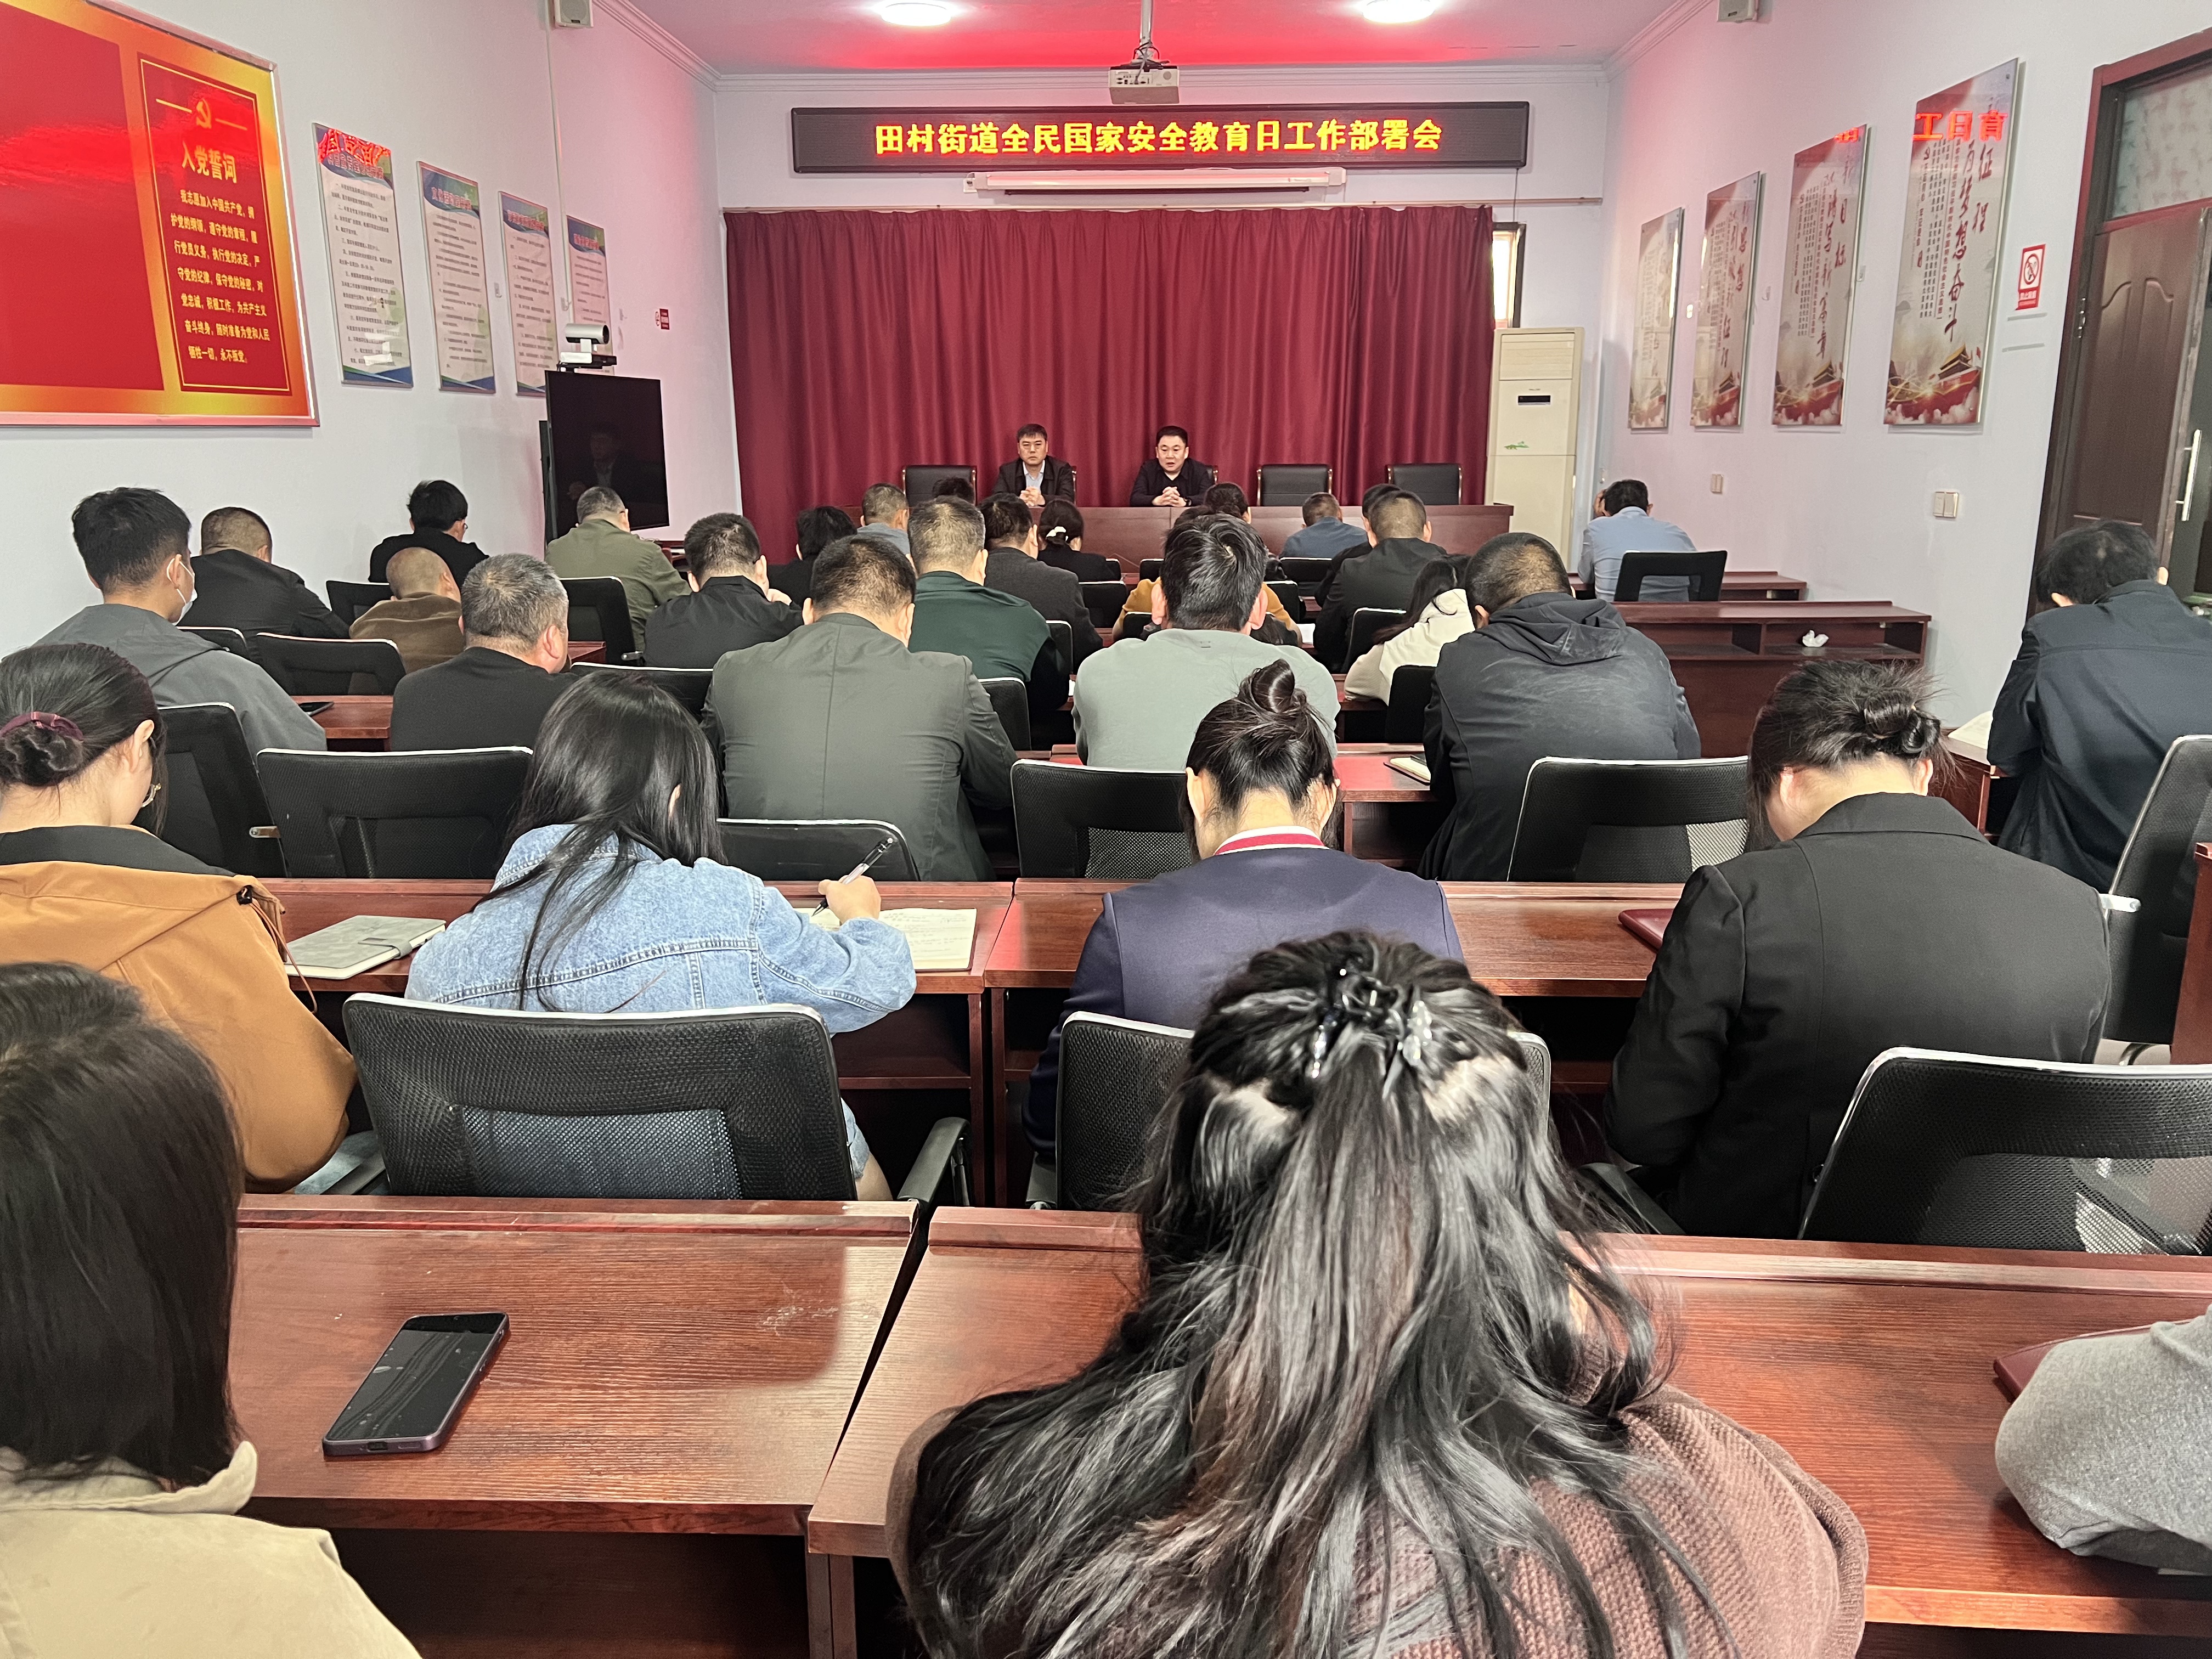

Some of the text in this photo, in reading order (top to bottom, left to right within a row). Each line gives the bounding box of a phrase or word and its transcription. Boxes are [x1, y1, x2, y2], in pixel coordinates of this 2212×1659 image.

[876, 119, 1442, 154] 田村街道全民国家安全教育日工作部署会
[182, 140, 237, 183] 入党誓词
